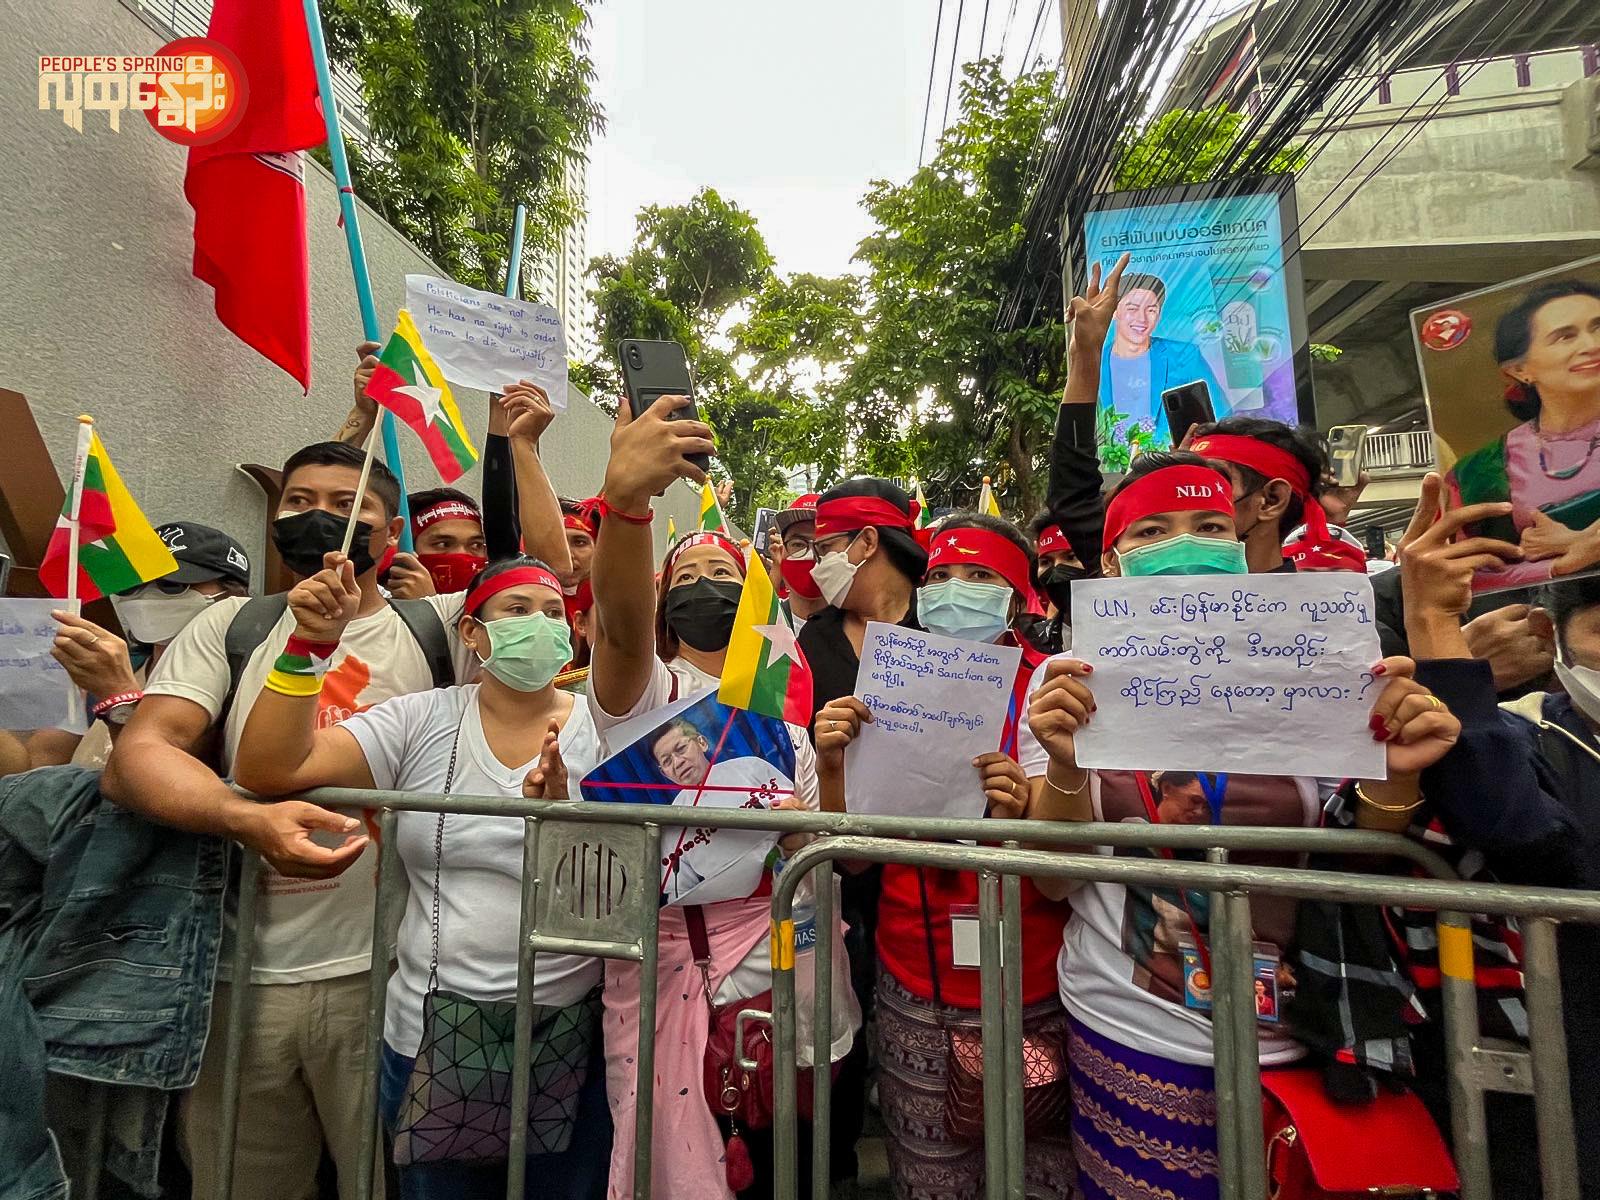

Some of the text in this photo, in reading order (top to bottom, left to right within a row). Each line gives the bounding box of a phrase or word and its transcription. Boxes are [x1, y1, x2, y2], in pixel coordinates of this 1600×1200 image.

[426, 282, 481, 307] Politicians
[509, 308, 525, 320] not
[427, 304, 443, 317] He
[448, 308, 466, 322] has
[474, 318, 486, 327] no
[494, 321, 513, 339] right
[521, 328, 529, 338] to
[428, 324, 456, 338] them
[466, 330, 475, 342] to
[482, 336, 499, 349] die
[1175, 483, 1212, 499] NLD
[1292, 552, 1307, 563] LD
[966, 651, 1002, 666] Action
[937, 667, 985, 683] Sanction
